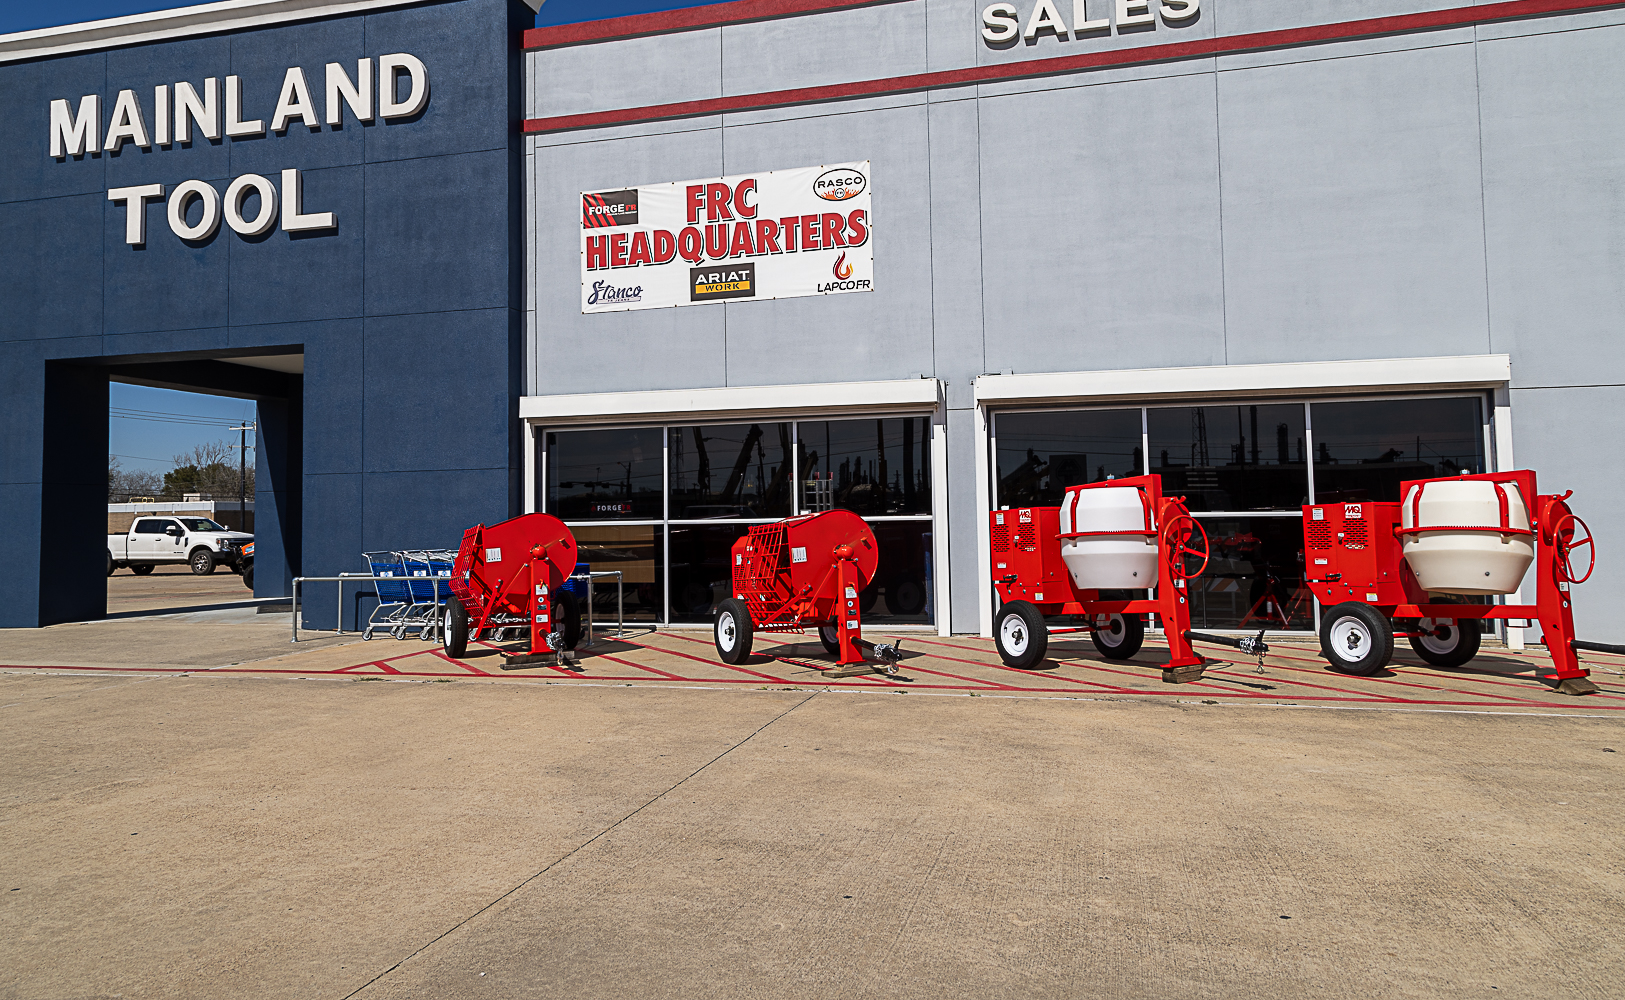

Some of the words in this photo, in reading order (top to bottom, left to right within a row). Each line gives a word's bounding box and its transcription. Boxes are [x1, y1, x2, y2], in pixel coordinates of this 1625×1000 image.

[981, 0, 1200, 42] SALES
[49, 53, 430, 159] MAINLAND
[686, 178, 758, 226] FRC
[817, 176, 863, 189] RASCO
[107, 168, 337, 245] TOOL
[586, 209, 869, 272] HEADQUARTERS
[587, 279, 644, 305] Stanco
[695, 269, 750, 285] ARIAT
[705, 282, 740, 292] WORK
